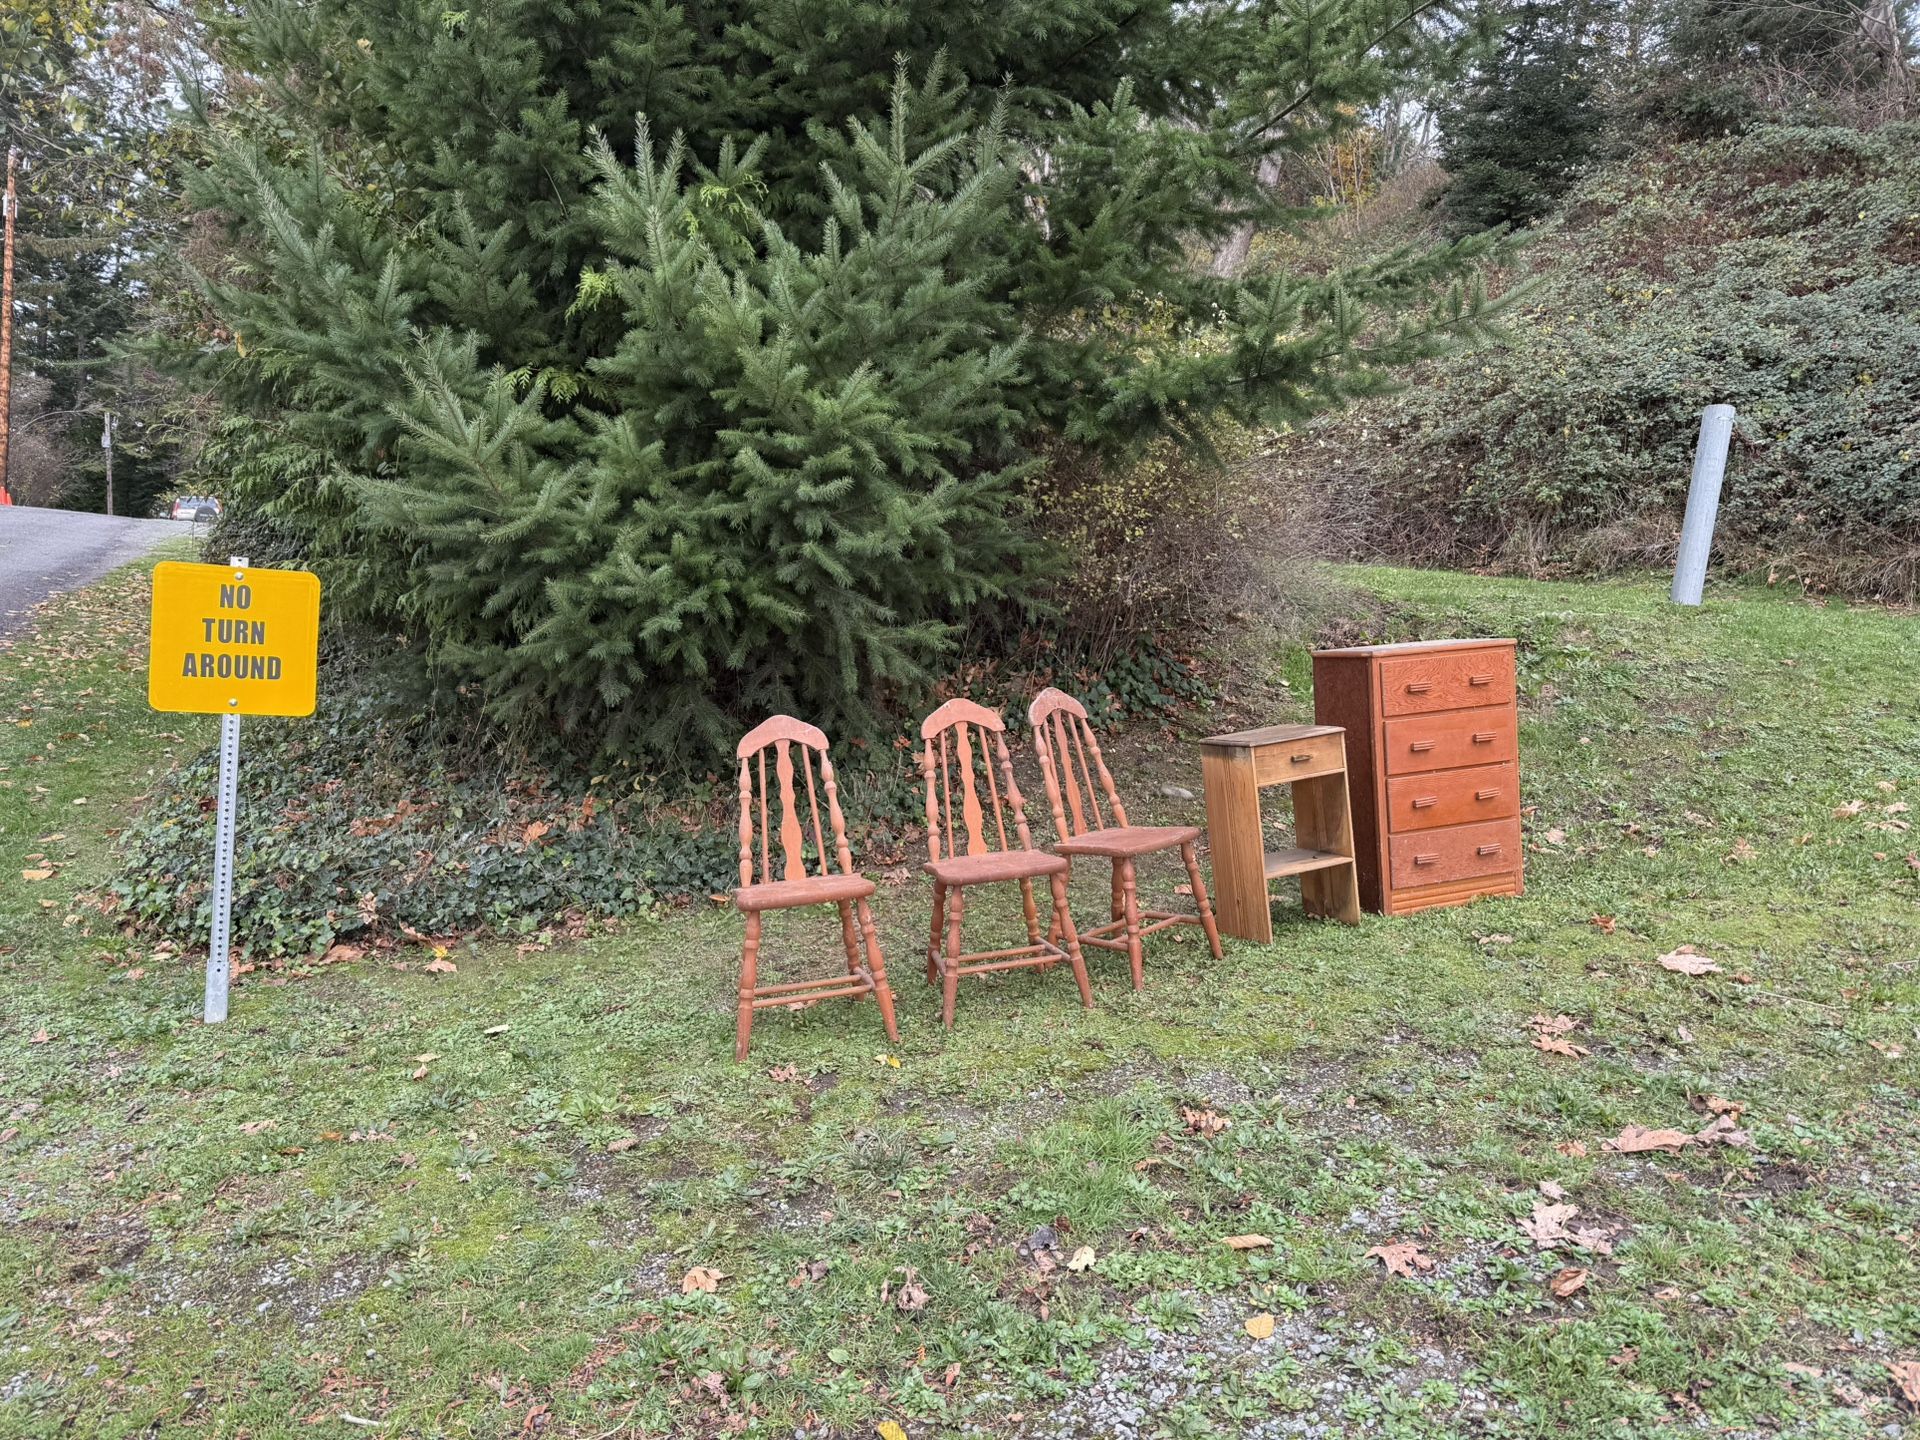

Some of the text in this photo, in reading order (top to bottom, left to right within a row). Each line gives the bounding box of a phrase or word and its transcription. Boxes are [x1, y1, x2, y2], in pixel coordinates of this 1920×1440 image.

[220, 584, 251, 609] NO
[202, 618, 265, 644] TURN
[182, 653, 281, 679] AROUND
